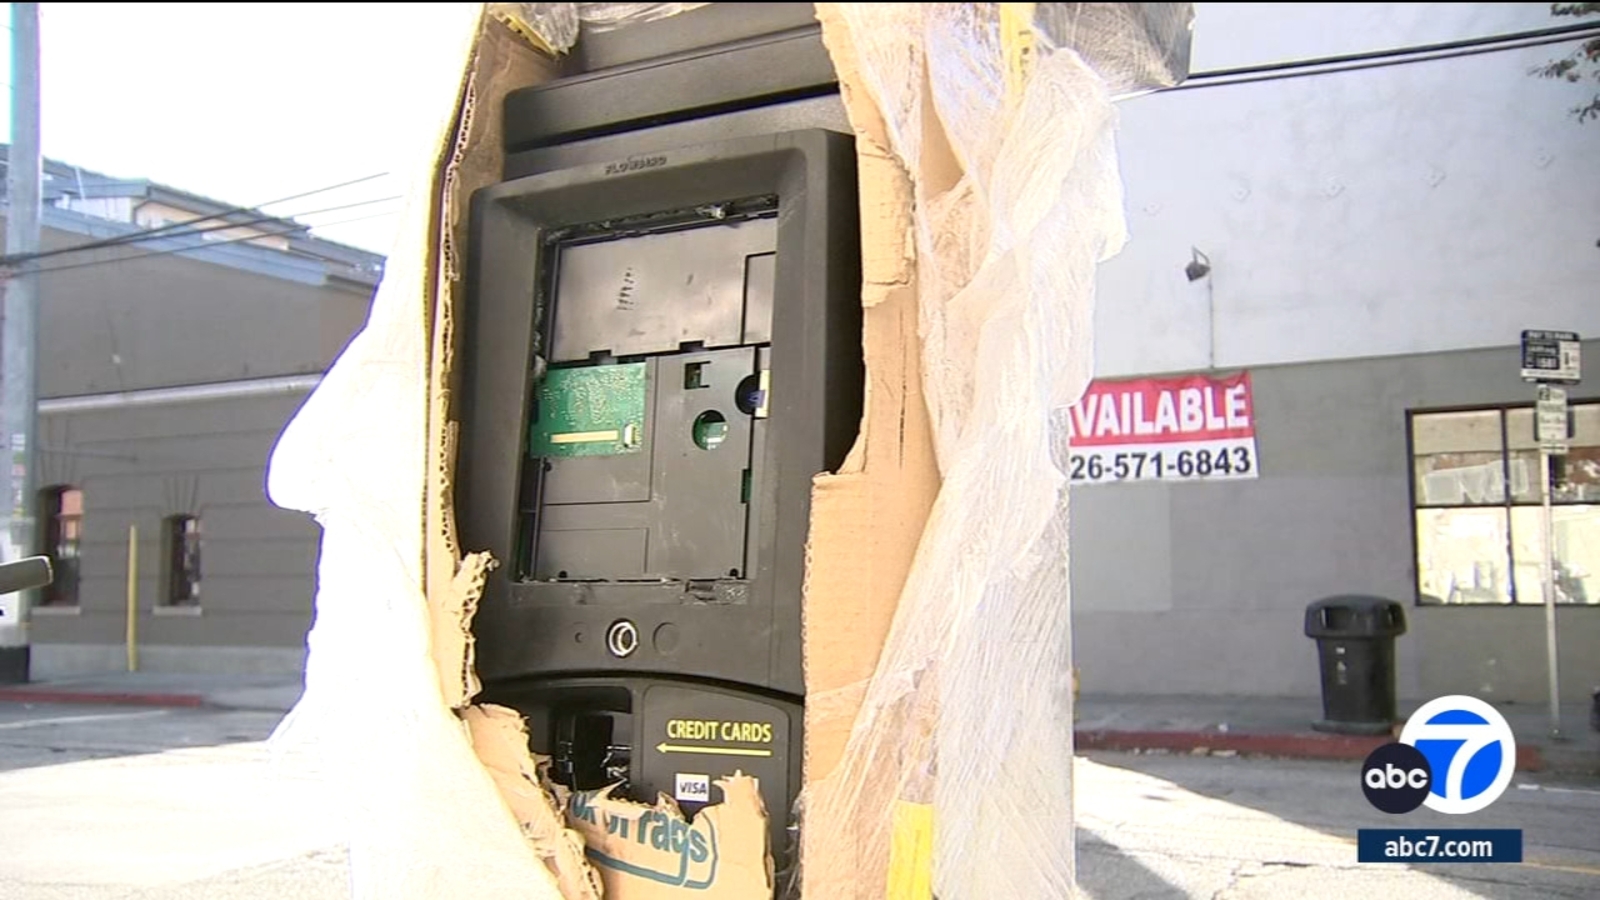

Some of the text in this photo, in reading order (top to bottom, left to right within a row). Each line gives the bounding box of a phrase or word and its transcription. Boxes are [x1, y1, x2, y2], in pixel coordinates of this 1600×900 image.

[1070, 446, 1251, 481] 26-571-6843
[667, 719, 772, 743] CREDIT CARDS
[680, 782, 707, 795] VISA
